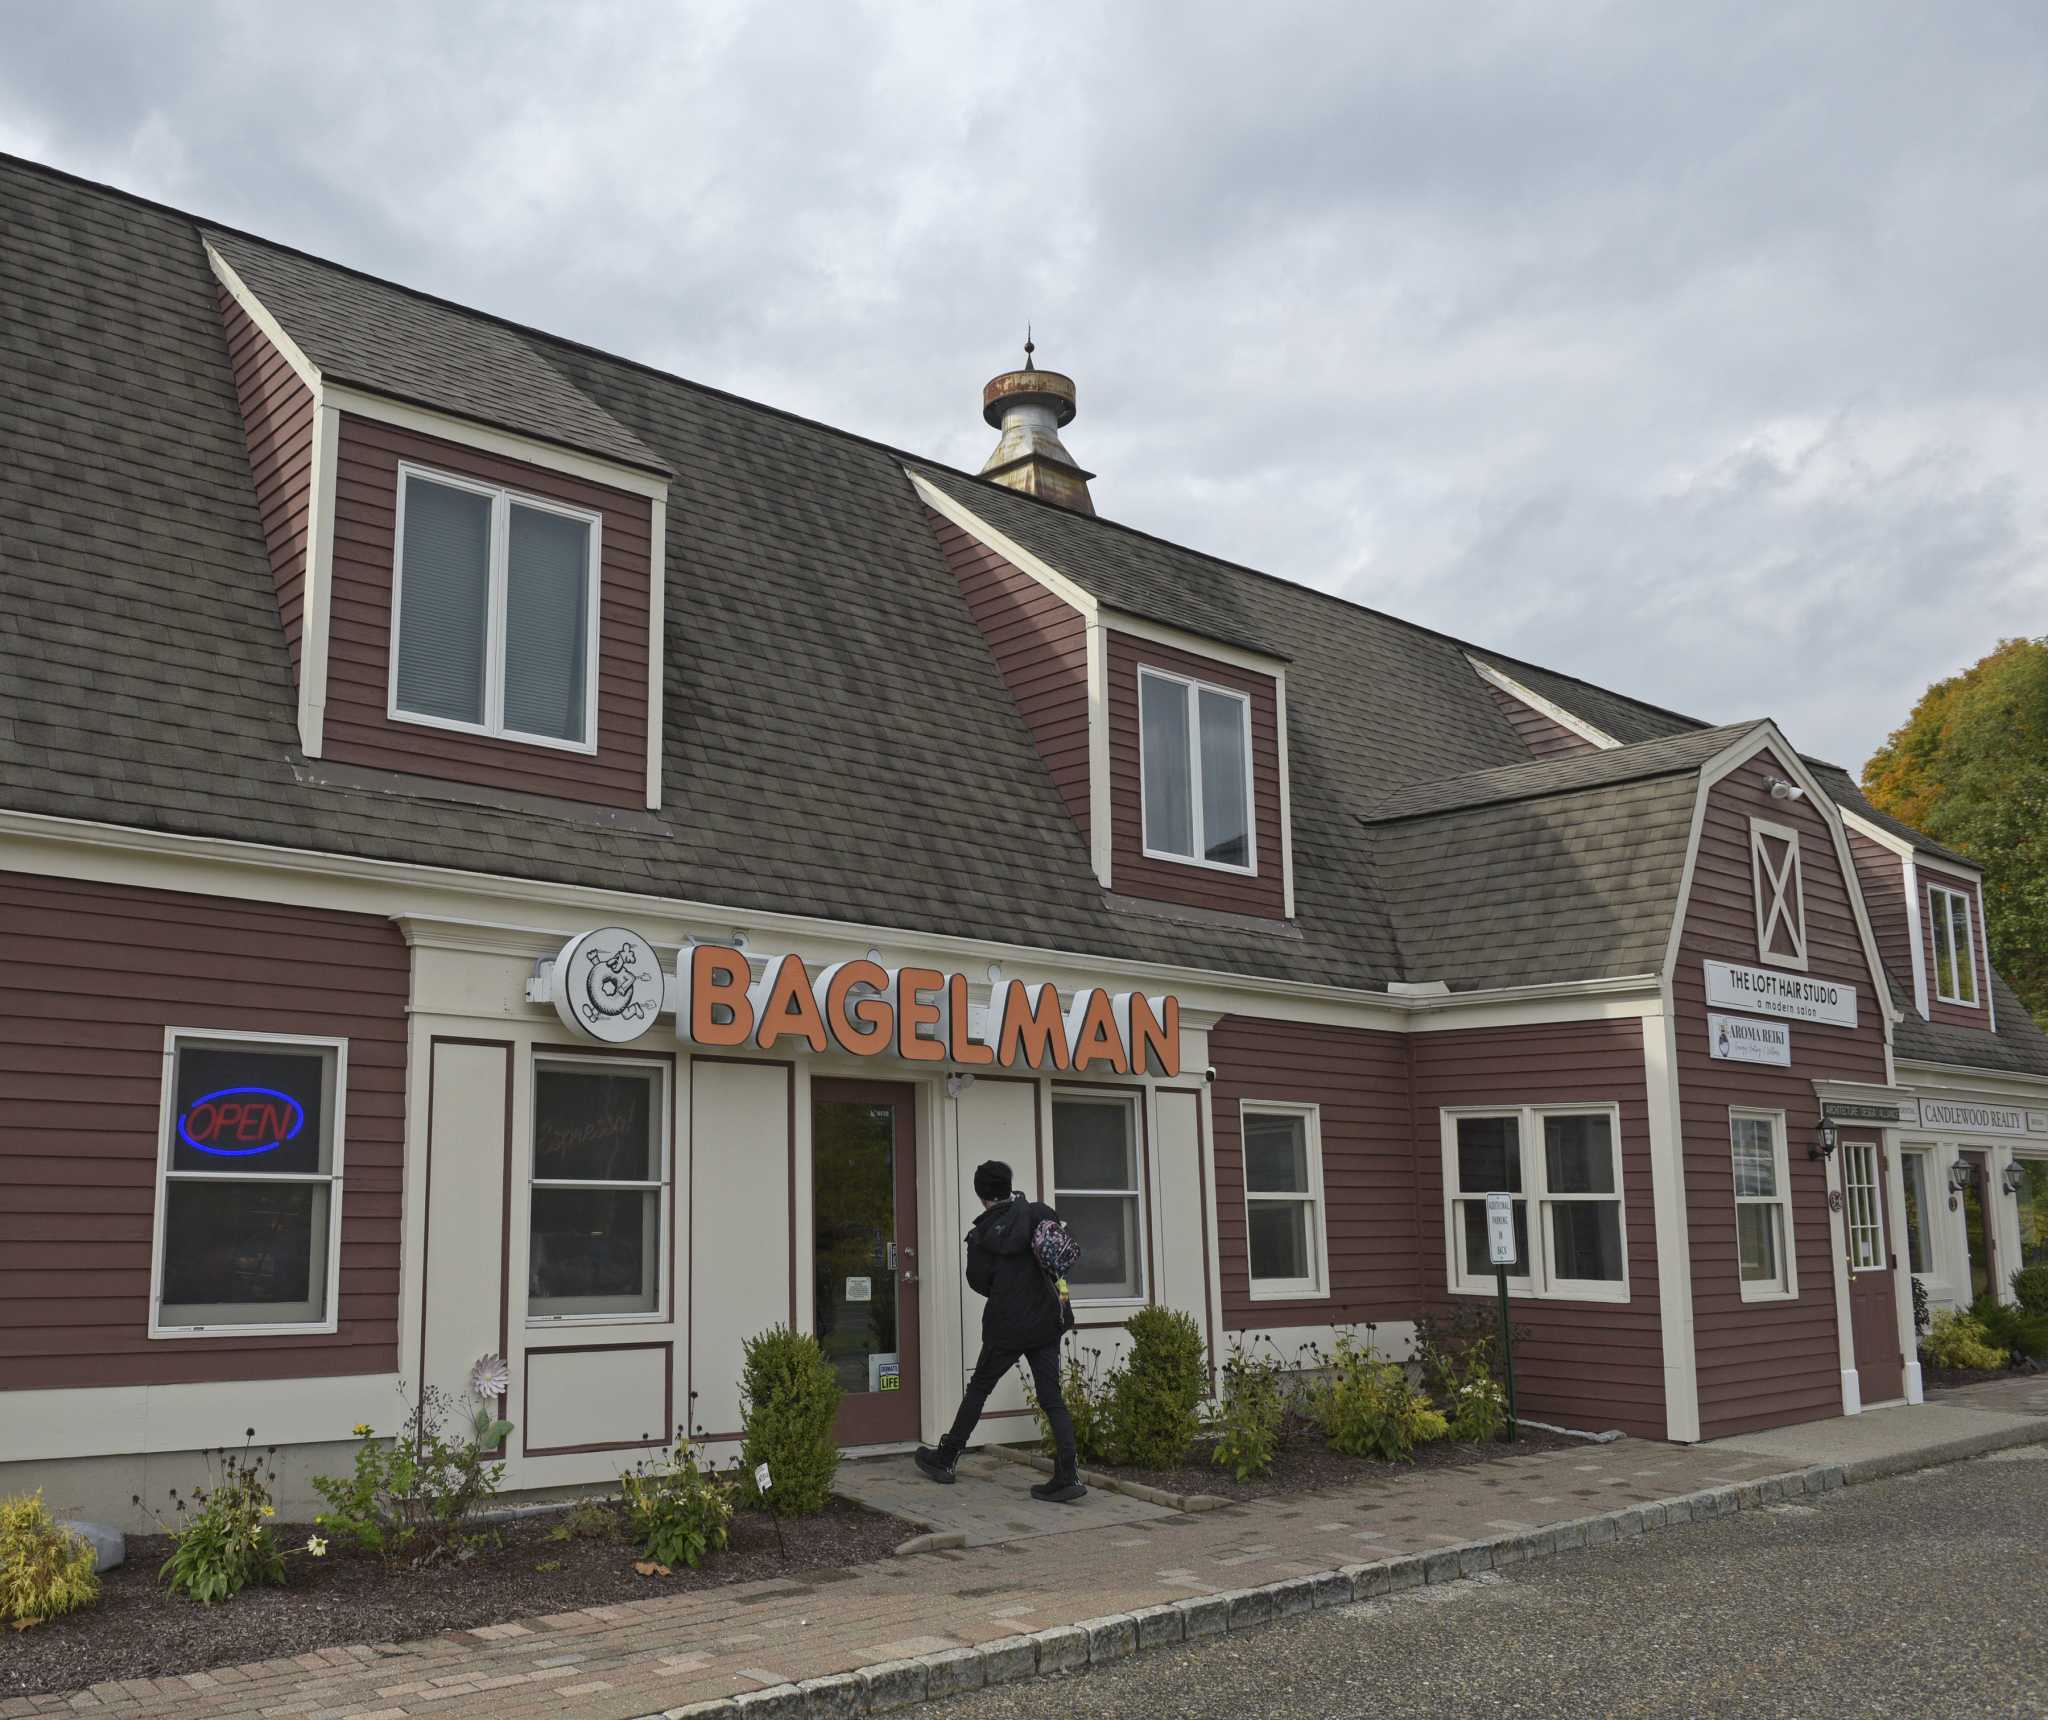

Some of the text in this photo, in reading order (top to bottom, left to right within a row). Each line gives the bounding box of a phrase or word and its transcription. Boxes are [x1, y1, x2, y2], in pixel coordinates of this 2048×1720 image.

[1730, 969, 1838, 1006] THE LOFT HAIR STUDIO
[688, 943, 1181, 1078] BAGELMAN
[1765, 1000, 1794, 1014] modern
[1796, 1004, 1817, 1017] salon
[1729, 1023, 1785, 1045] AROMA REIKI
[187, 1103, 293, 1141] OPEN
[1925, 1104, 2021, 1129] CANDLEWOOD REALTY
[881, 1377, 898, 1389] LIFE
